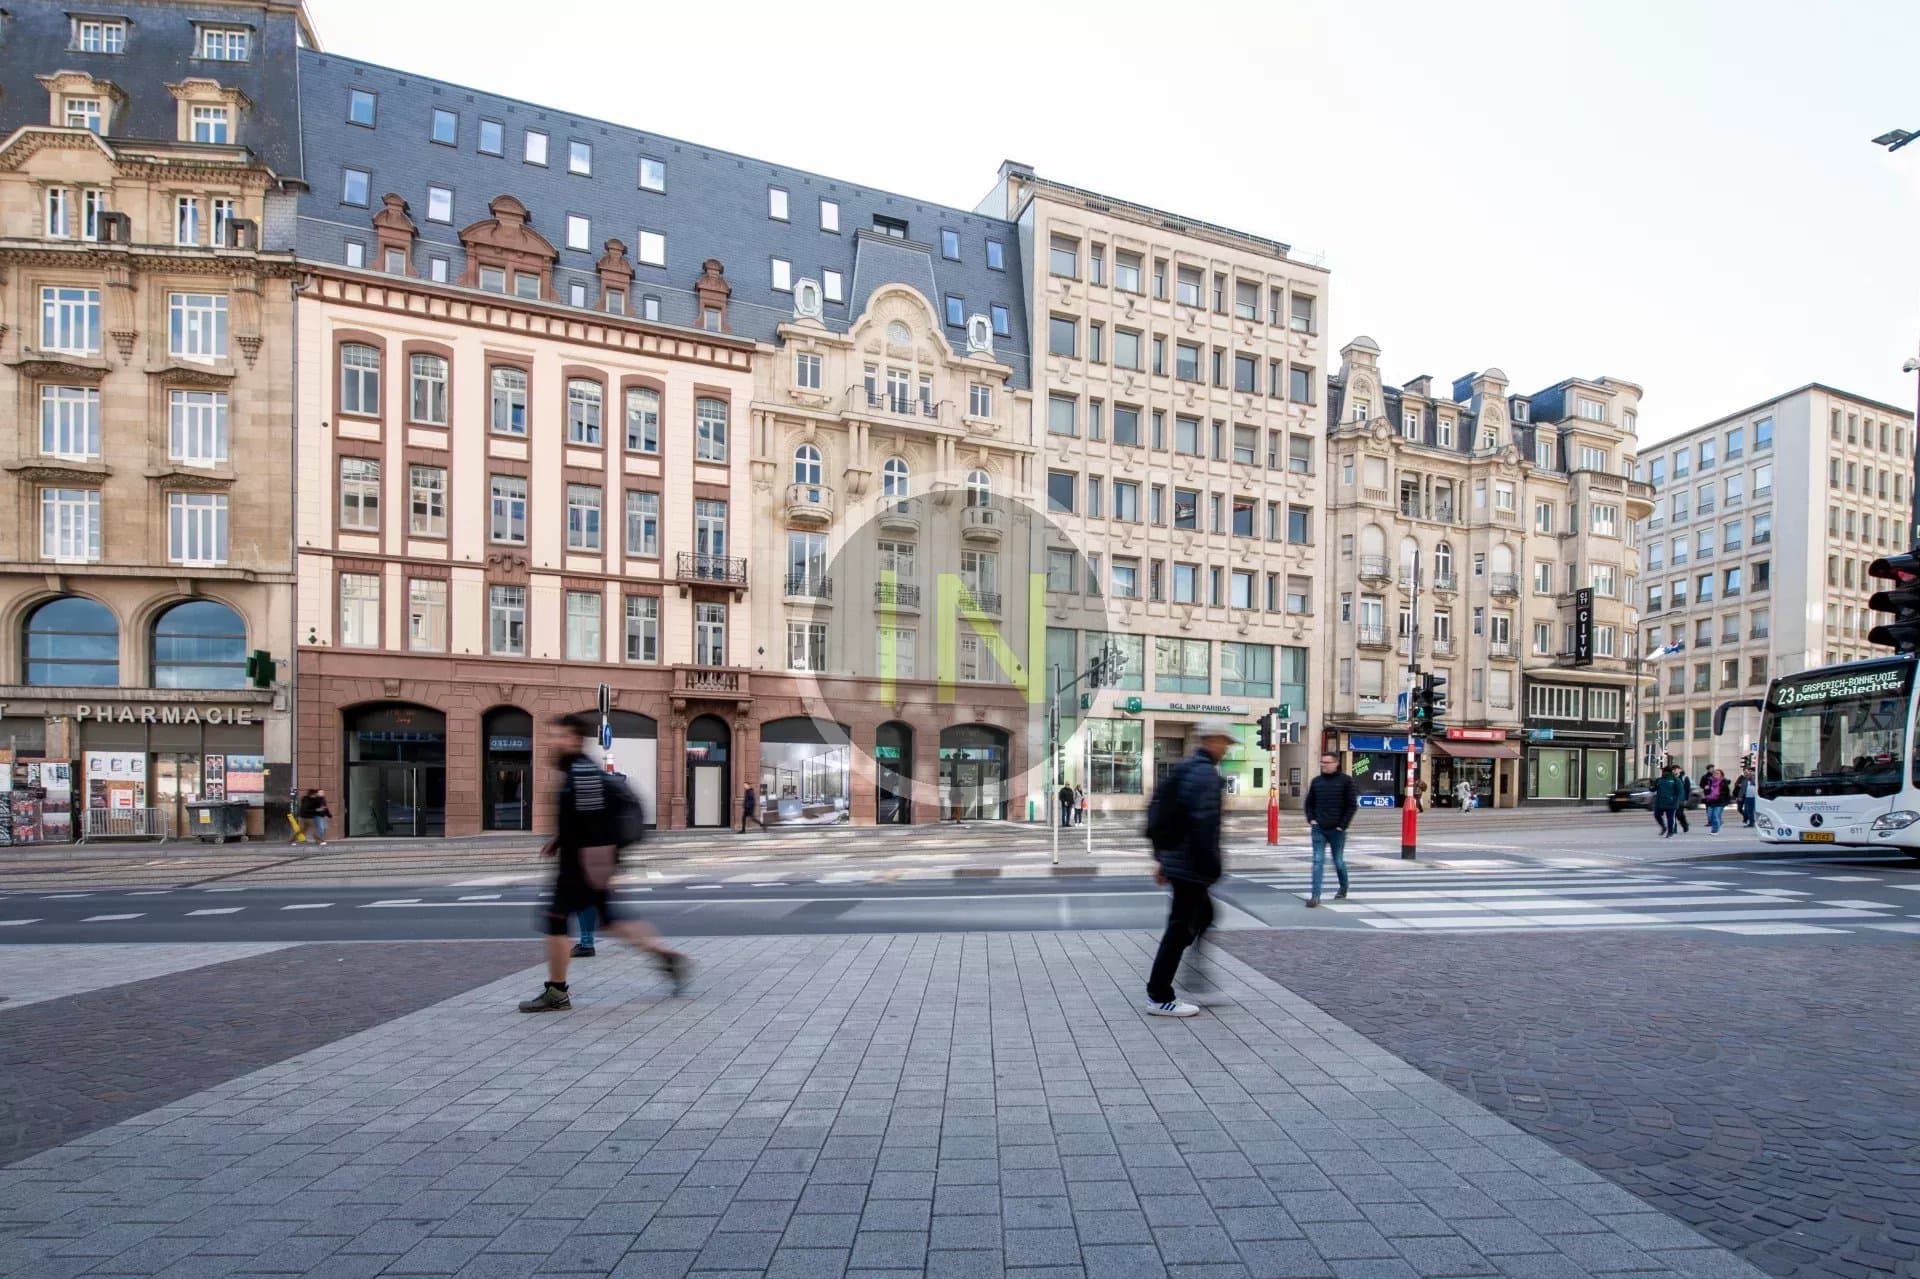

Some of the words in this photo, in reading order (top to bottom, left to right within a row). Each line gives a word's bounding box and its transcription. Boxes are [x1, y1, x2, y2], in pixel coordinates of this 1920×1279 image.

[1580, 611, 1588, 657] CITY
[1777, 687, 1795, 705] 23
[1795, 691, 1827, 702] Demy
[1829, 680, 1905, 697] Schlechter
[76, 704, 253, 725] PHARMACIE
[1201, 704, 1231, 712] PARIBAS
[1383, 737, 1393, 750] K
